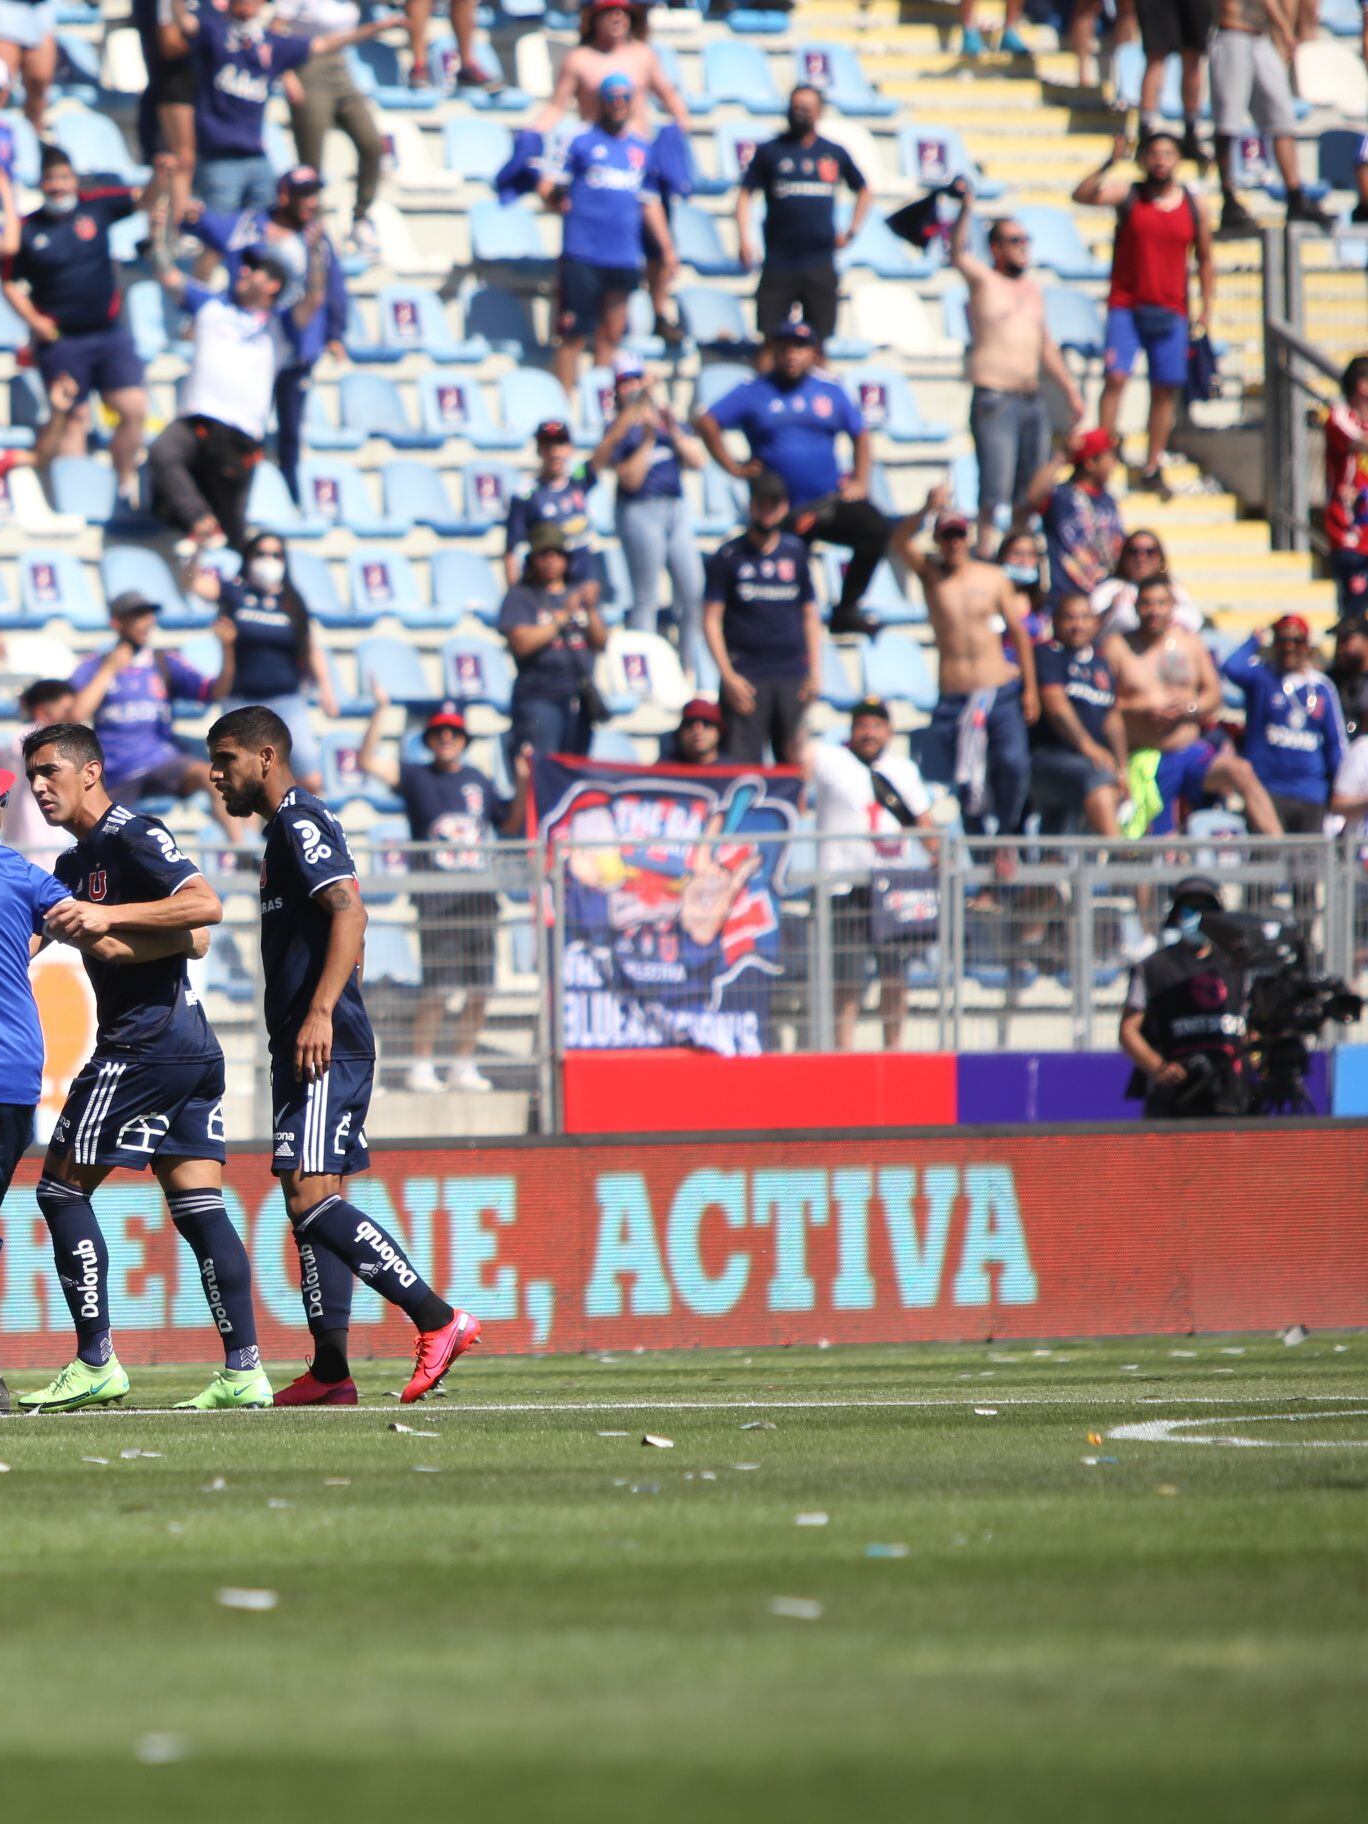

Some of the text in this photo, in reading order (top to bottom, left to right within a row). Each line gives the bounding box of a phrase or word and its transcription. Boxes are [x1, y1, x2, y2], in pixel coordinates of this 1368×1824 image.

[72, 1239, 99, 1318] Dolorub
[353, 1221, 418, 1289] Dolorub
[584, 1163, 1038, 1318] ACTIVA
[202, 1257, 233, 1333] Dolorub
[300, 1243, 324, 1318] Dolorub
